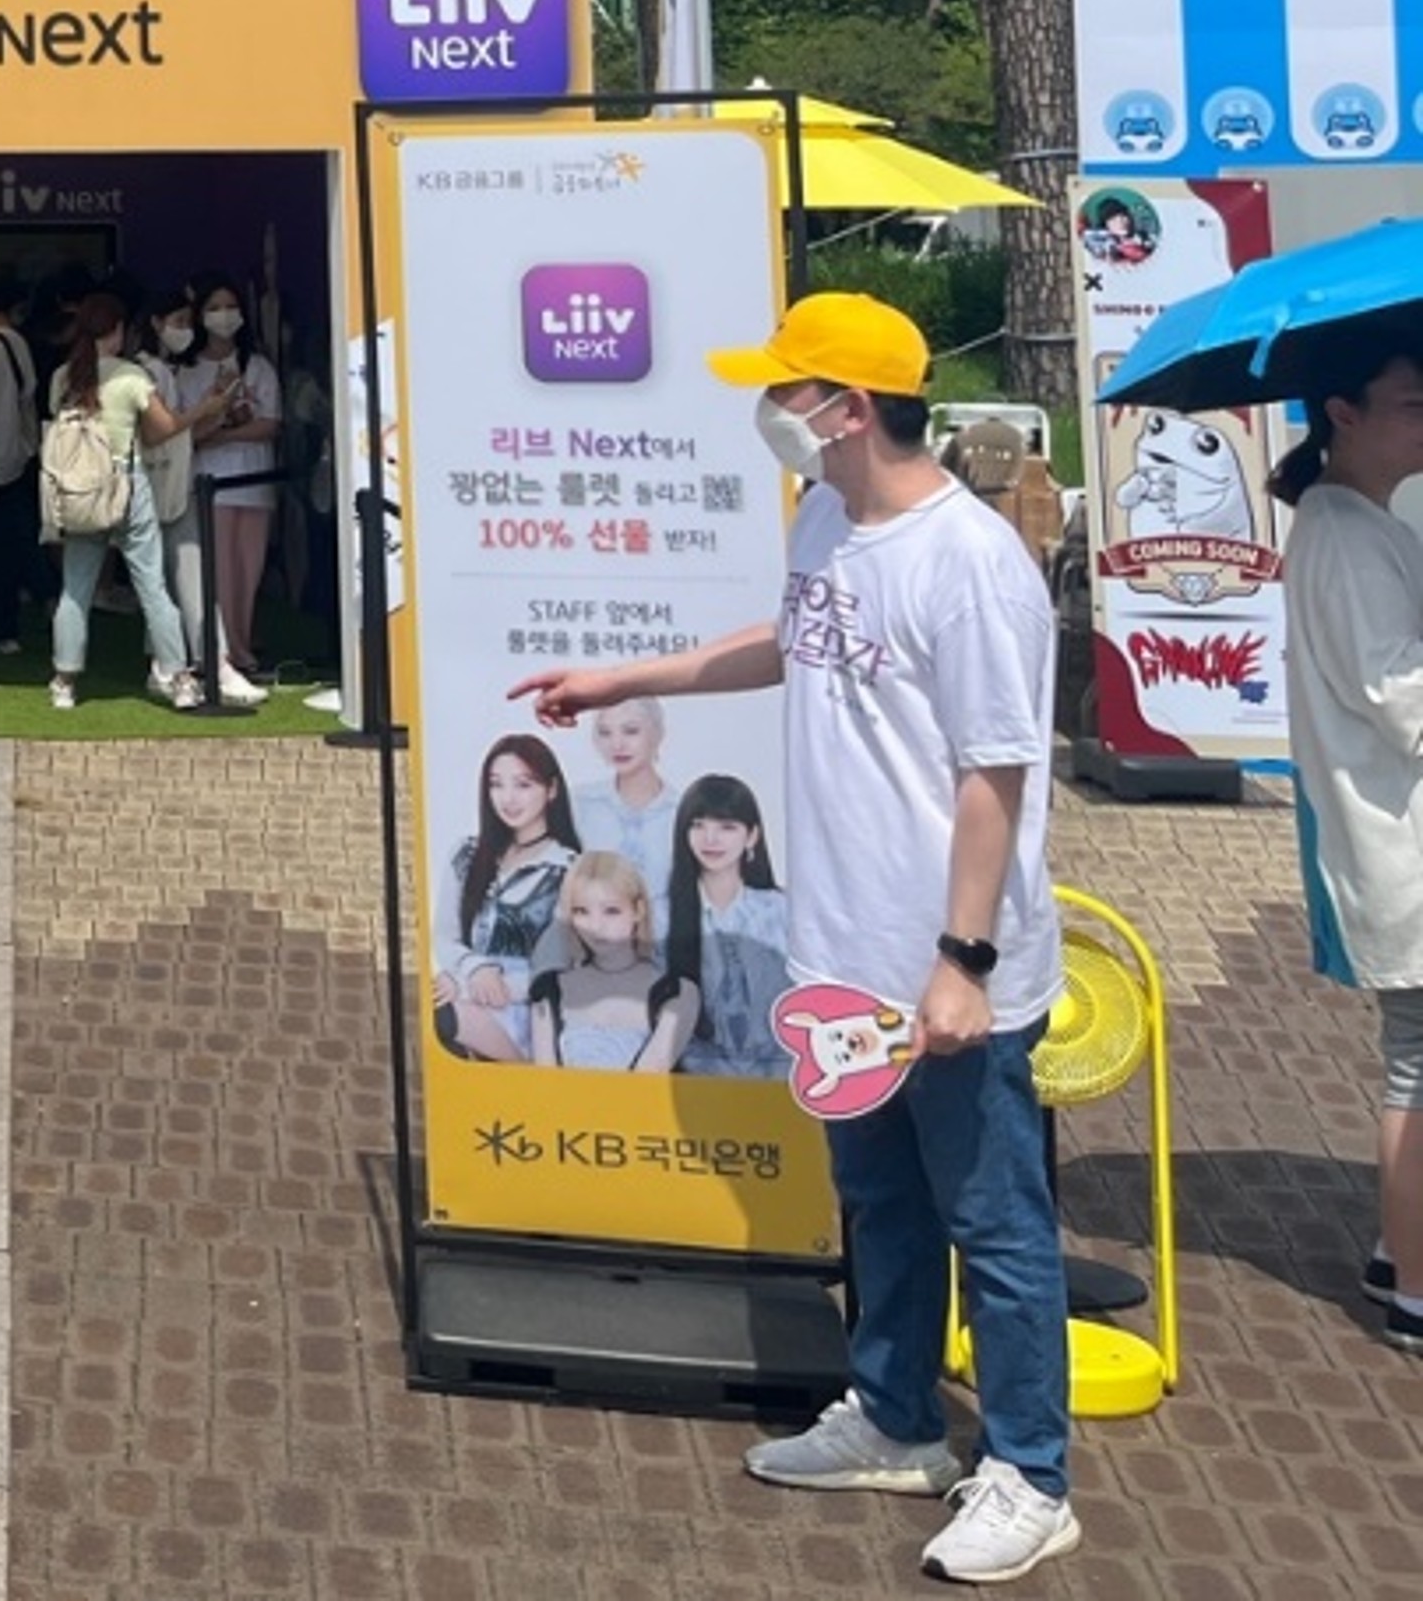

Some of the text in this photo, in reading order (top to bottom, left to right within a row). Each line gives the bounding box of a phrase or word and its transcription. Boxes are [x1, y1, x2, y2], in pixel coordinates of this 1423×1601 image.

[411, 29, 517, 69] Next
[55, 188, 124, 214] Next
[541, 293, 635, 334] Liiv
[555, 336, 621, 360] Next
[489, 427, 555, 460] 리브
[556, 470, 621, 507] 룰렛
[635, 481, 698, 507] 돌리고
[478, 517, 575, 550] 100%
[588, 518, 652, 555] 선물
[1129, 539, 1259, 565] COMING SOON
[528, 598, 674, 626] STAFF 앞에서
